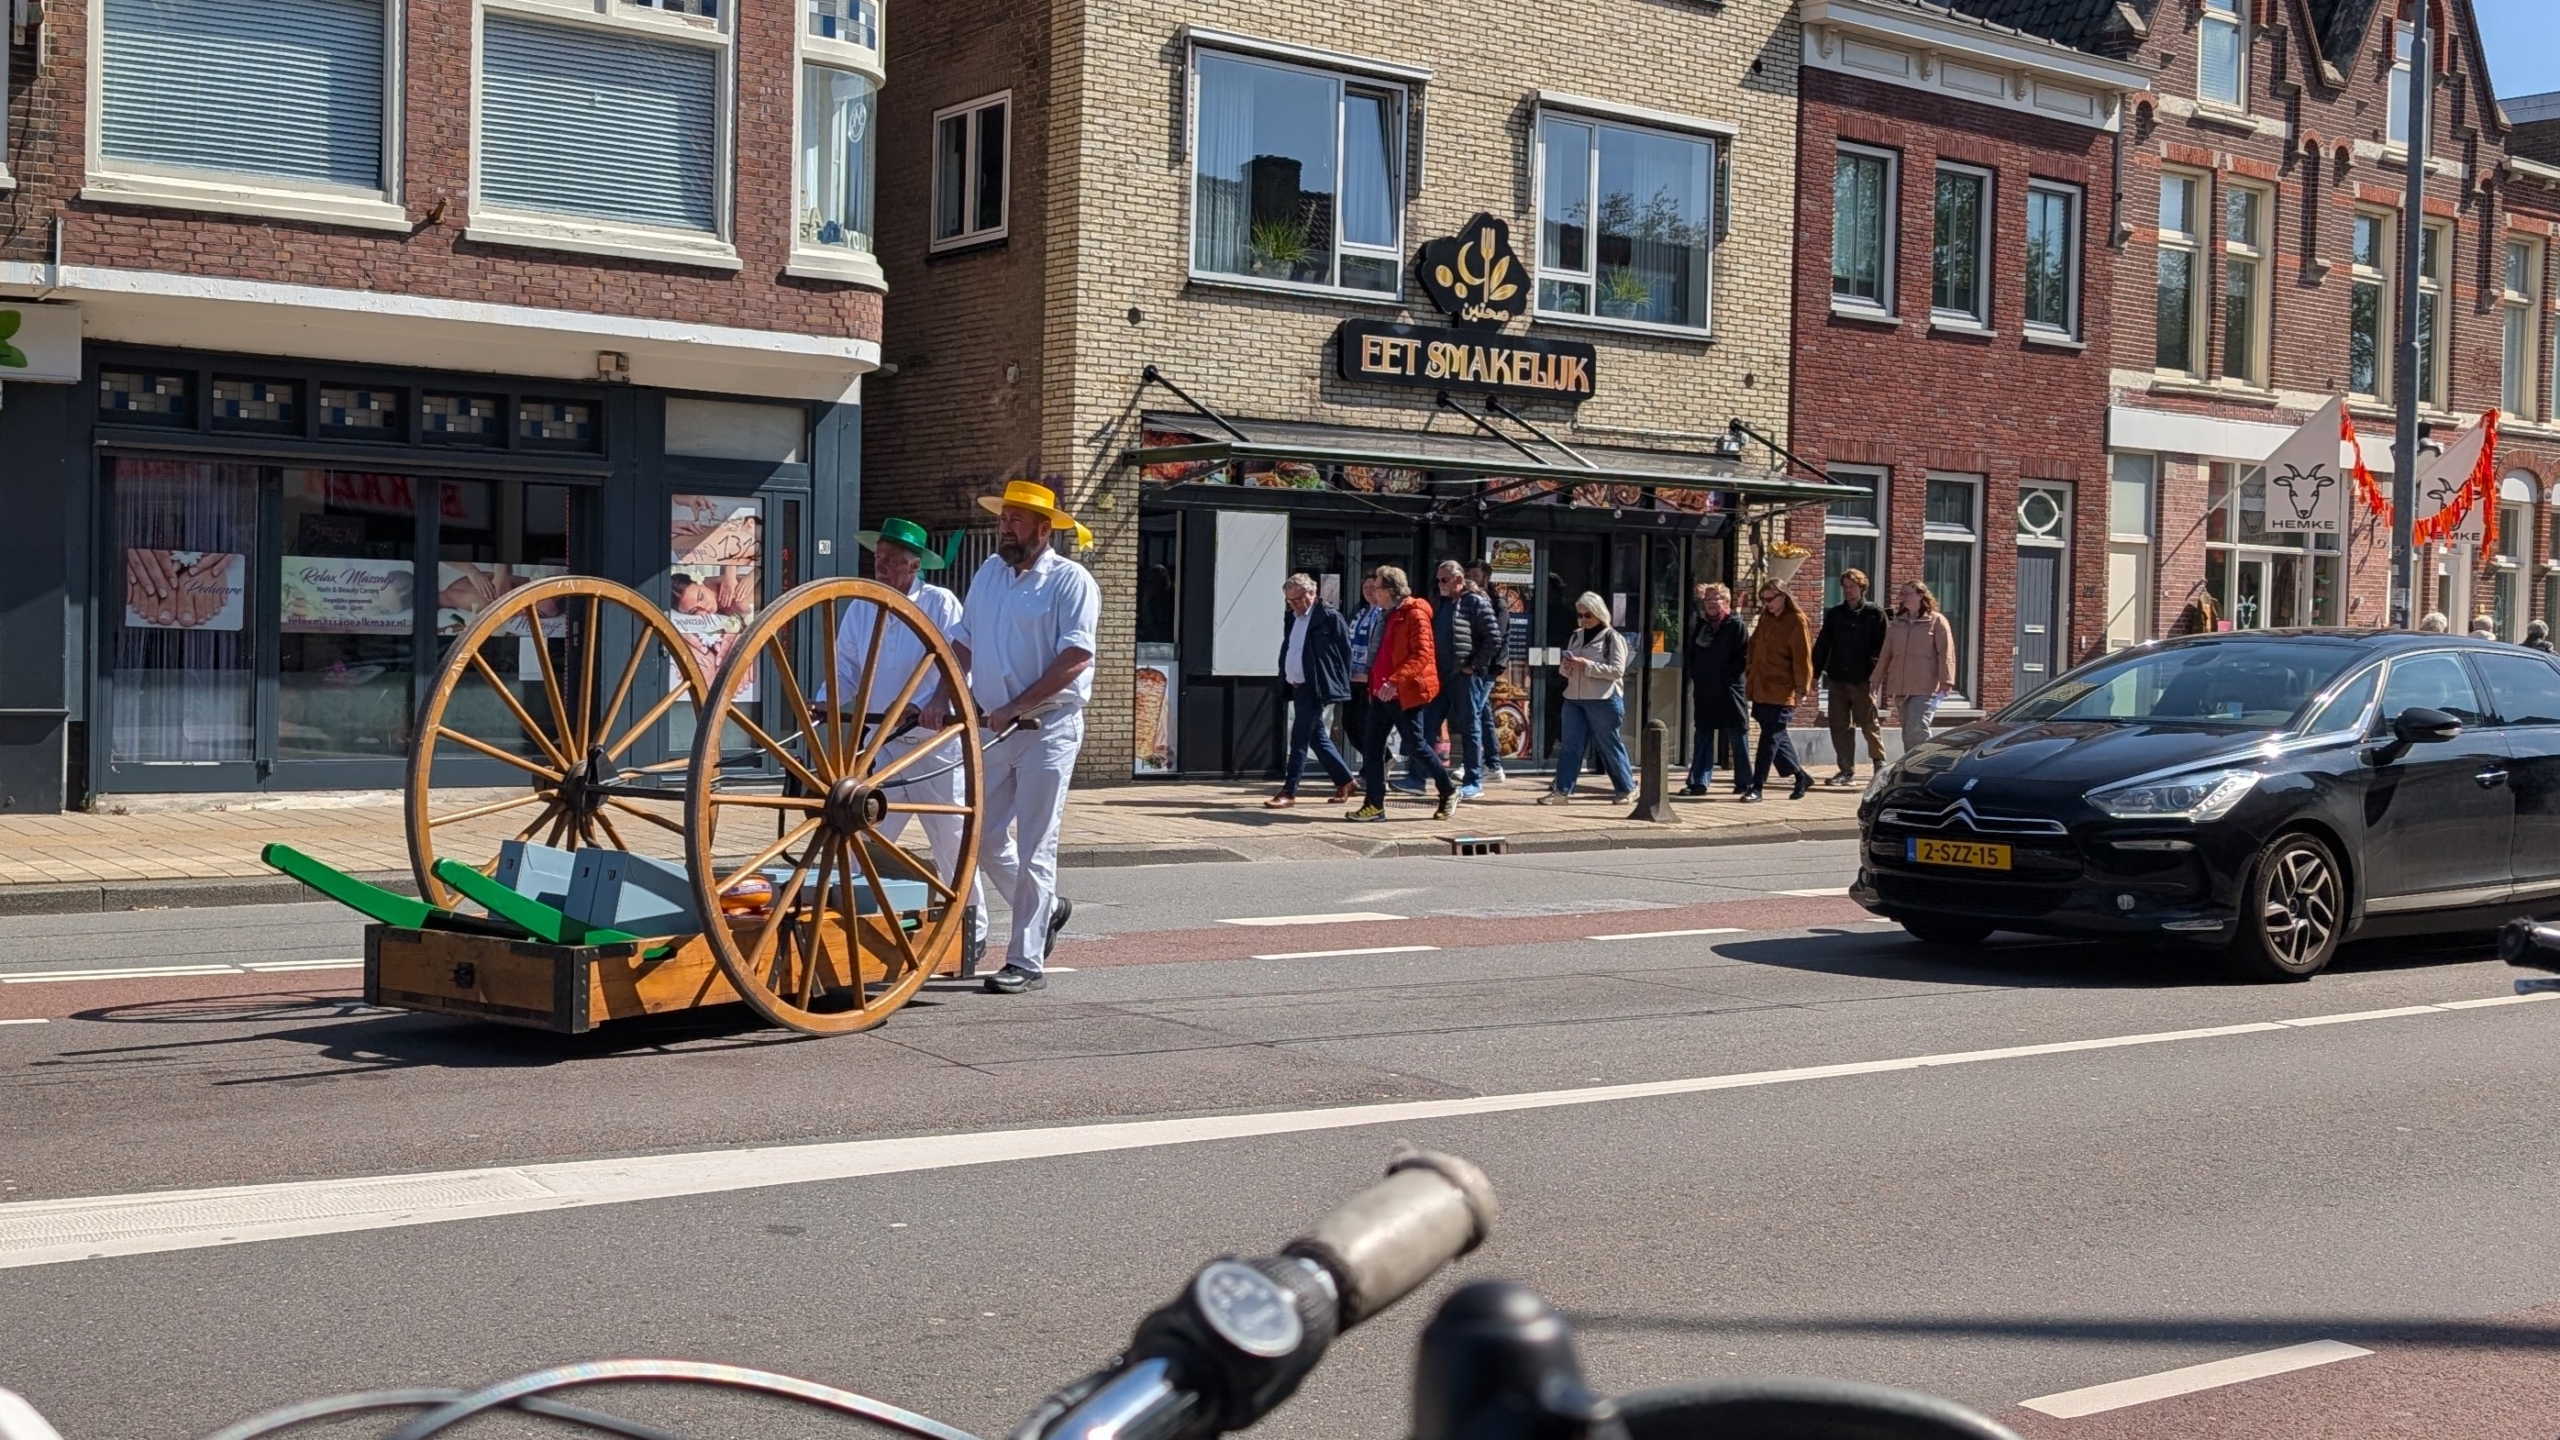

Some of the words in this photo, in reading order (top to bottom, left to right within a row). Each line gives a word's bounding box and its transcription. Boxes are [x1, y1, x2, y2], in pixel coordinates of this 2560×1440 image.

[1361, 334, 1422, 376] EET
[1425, 341, 1590, 393] SMAKELIJK
[2272, 519, 2335, 530] HEMKE
[2431, 531, 2481, 541] EMKE
[300, 566, 337, 585] Relax
[340, 568, 396, 591] Massage
[183, 579, 243, 596] Pedicure
[288, 617, 407, 629] relaxmassagealkmaar.nl
[1924, 842, 1999, 866] 2-SZZ-15
